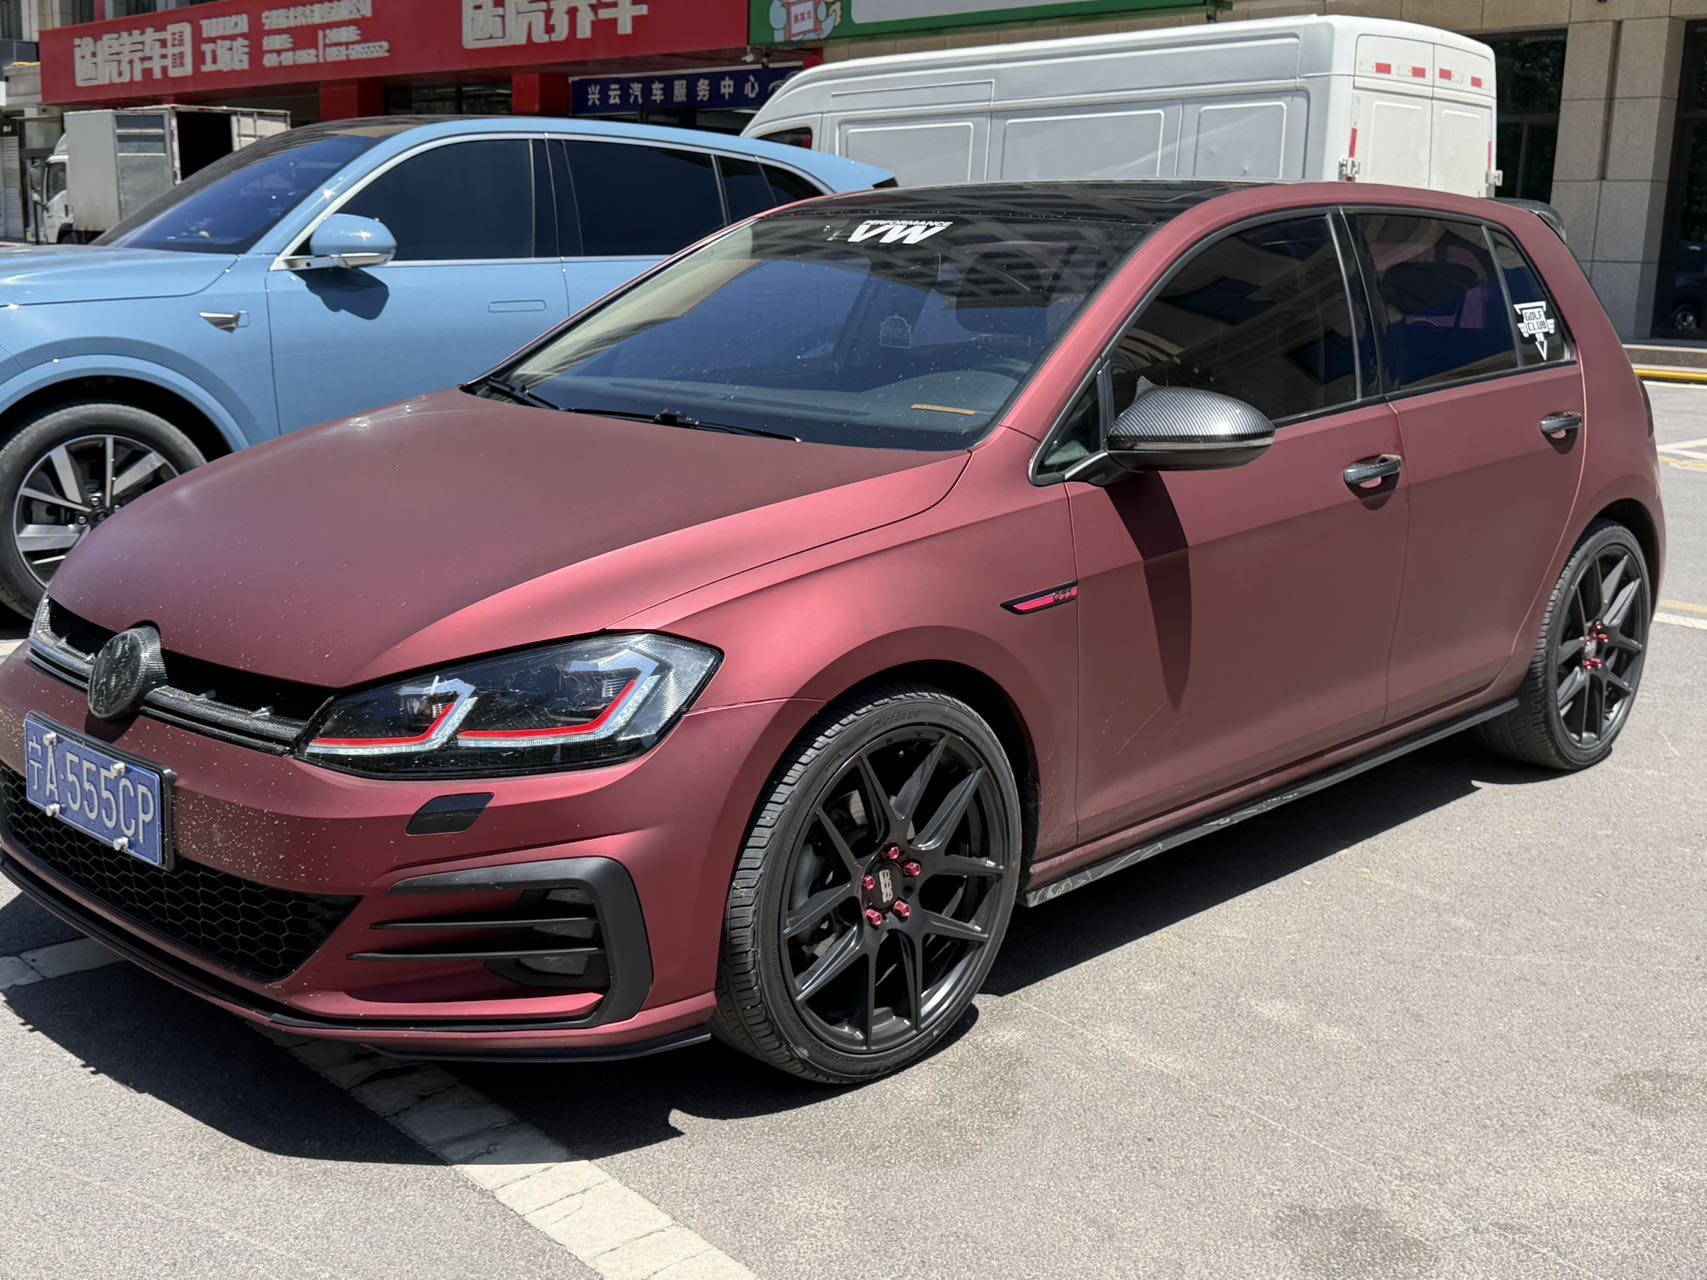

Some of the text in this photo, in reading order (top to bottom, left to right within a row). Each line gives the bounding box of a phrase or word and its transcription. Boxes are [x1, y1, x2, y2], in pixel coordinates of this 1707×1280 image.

[201, 38, 249, 72] 工场店
[587, 76, 759, 107] 兴云汽车服务中心
[847, 224, 948, 245] VW
[1524, 310, 1542, 321] GOLF
[1527, 320, 1547, 331] CLUB
